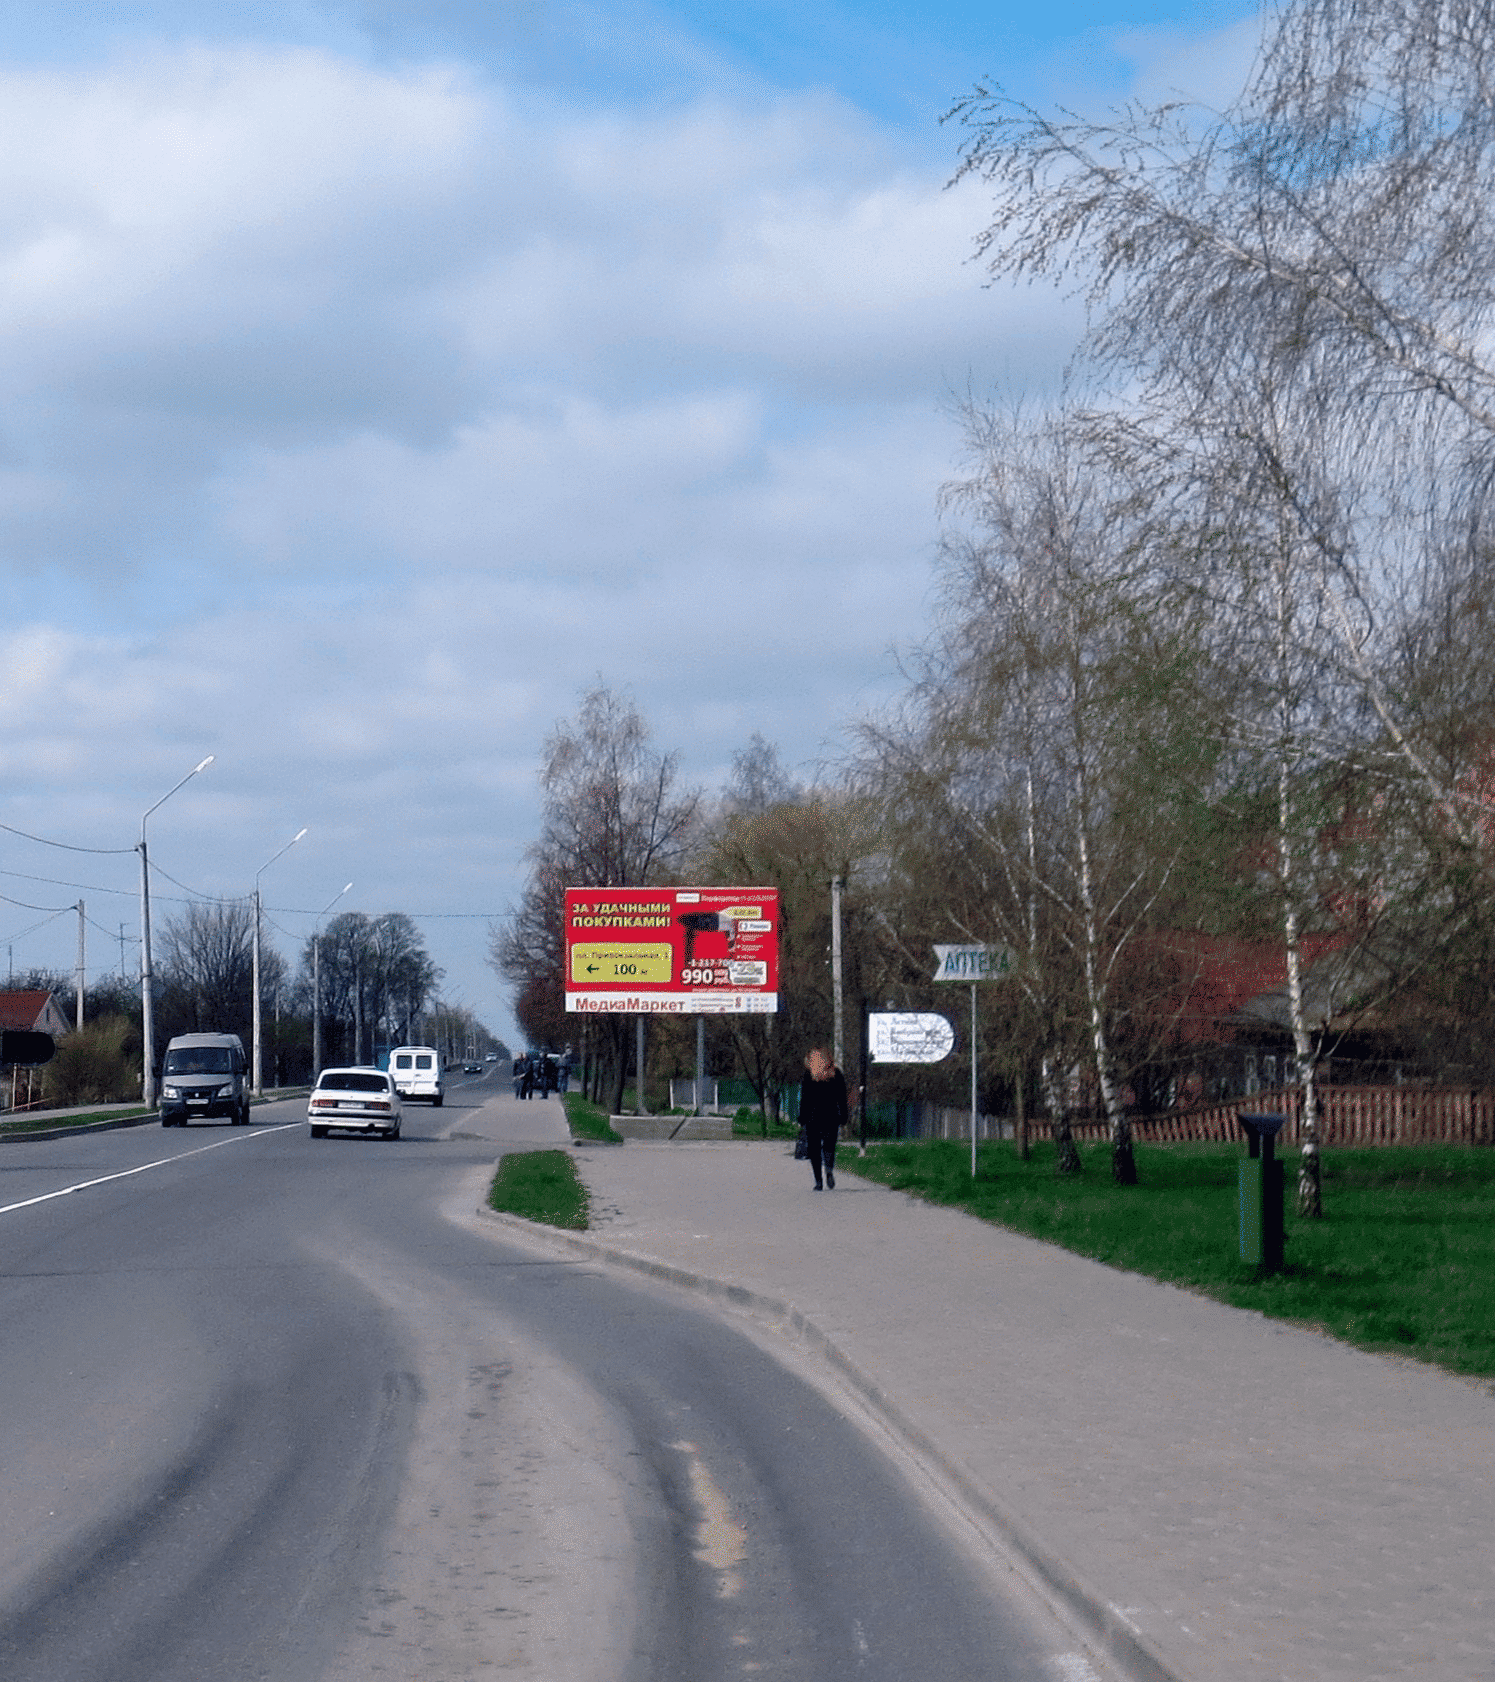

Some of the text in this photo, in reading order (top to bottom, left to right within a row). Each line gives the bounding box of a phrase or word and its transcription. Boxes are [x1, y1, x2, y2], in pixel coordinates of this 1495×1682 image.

[572, 903, 671, 914] ЗА УДАЧНЫМИ
[572, 916, 671, 927] ПОКУПКАМИ!
[944, 951, 1009, 972] АПТЕКА
[613, 964, 637, 976] 100
[682, 968, 713, 985] 990
[575, 997, 685, 1011] МедиаМаркет
